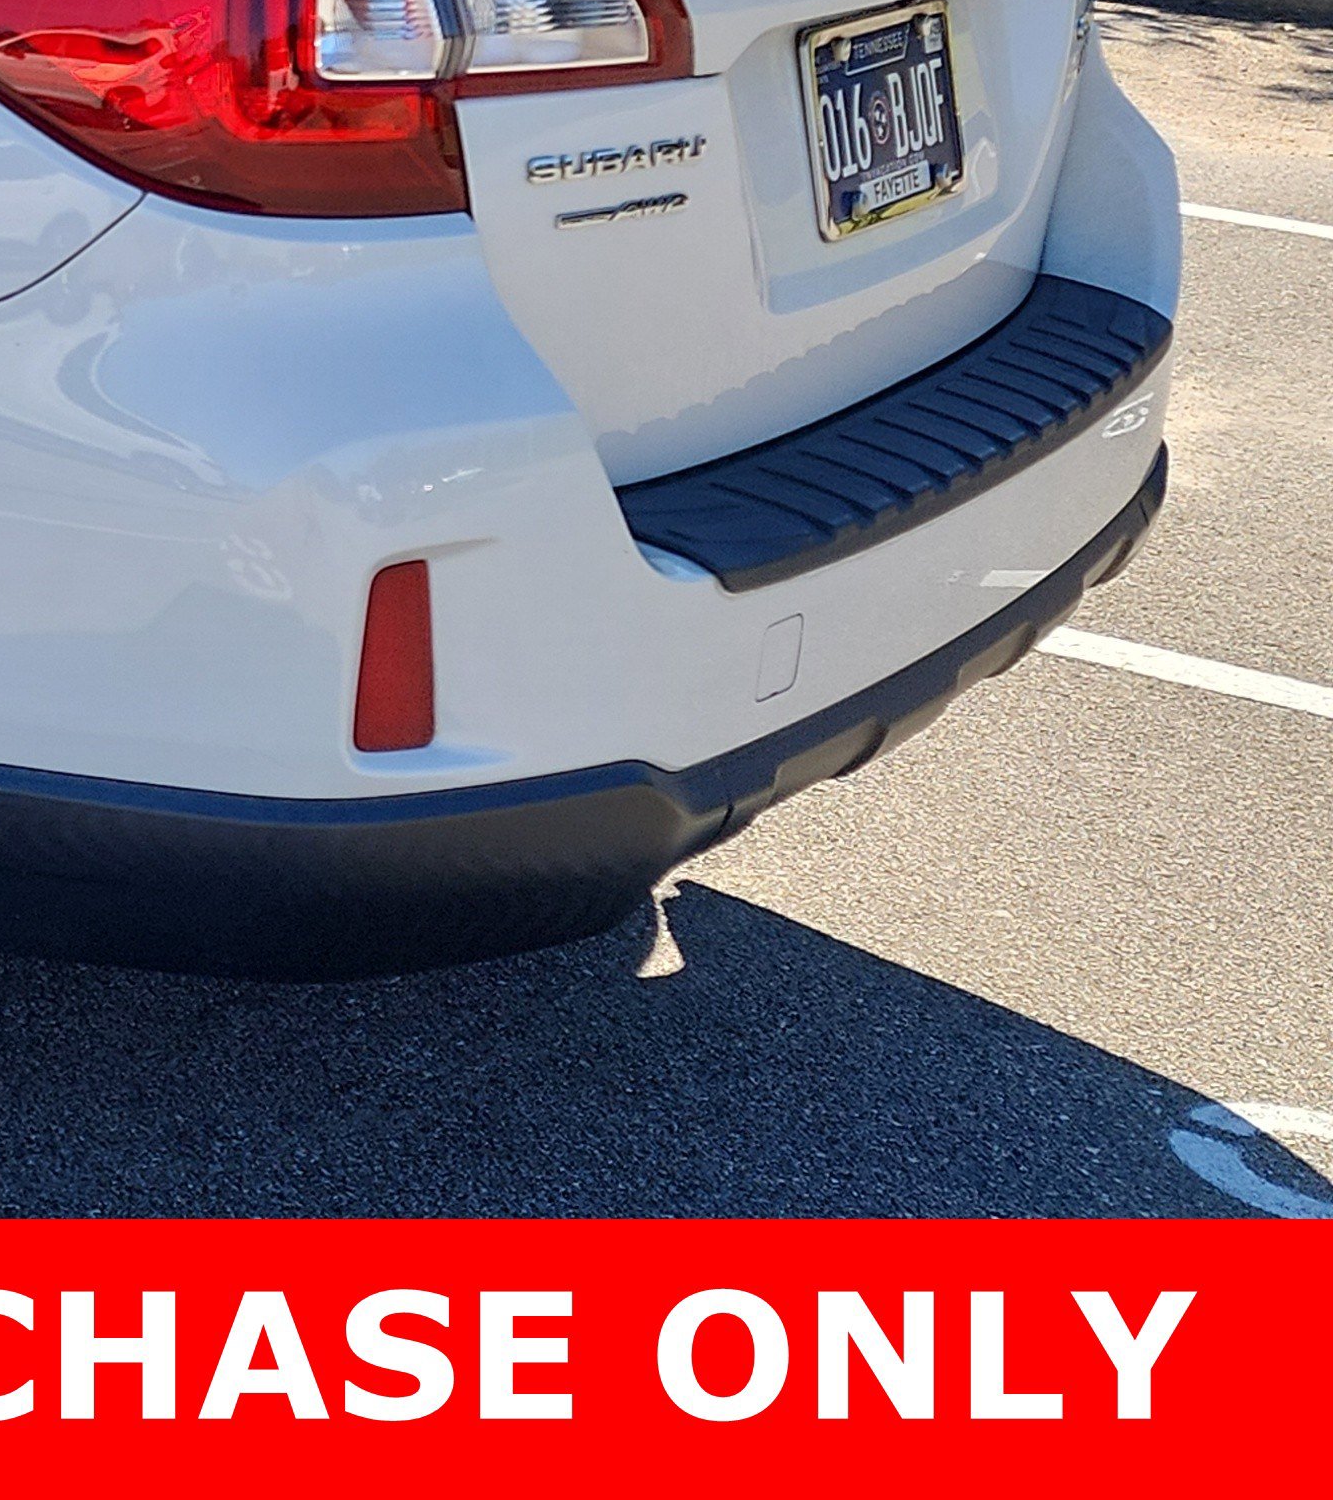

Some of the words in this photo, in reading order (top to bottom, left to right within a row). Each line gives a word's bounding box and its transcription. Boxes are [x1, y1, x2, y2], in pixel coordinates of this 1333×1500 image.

[853, 30, 904, 60] TENNESSEE
[526, 134, 707, 184] SUBARU
[873, 169, 921, 203] FAYETTE
